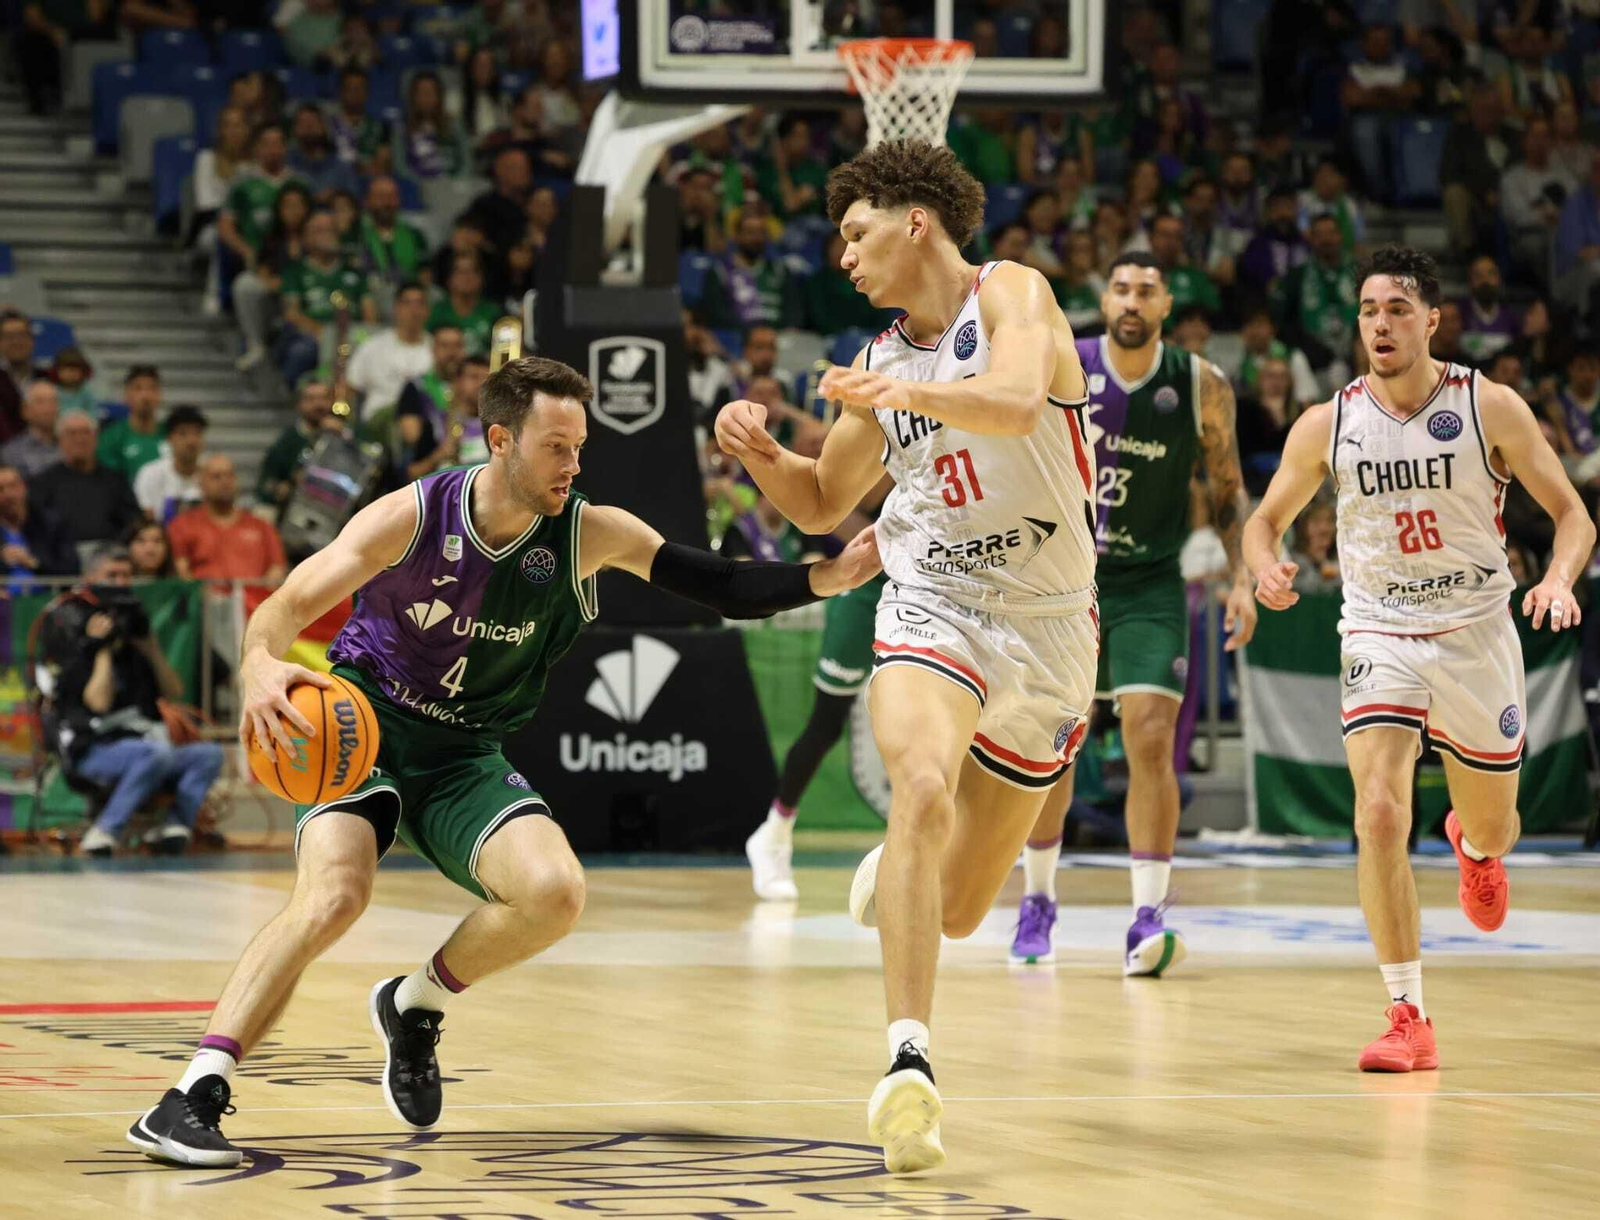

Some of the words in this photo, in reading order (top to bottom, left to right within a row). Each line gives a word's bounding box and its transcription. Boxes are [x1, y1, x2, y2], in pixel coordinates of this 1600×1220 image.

[1105, 434, 1167, 461] Unicaja
[934, 448, 984, 508] 31
[1096, 466, 1133, 507] 23
[1357, 453, 1456, 497] CHOLET
[1395, 509, 1444, 554] 26
[452, 616, 536, 647] Unicaja
[439, 656, 469, 698] 4
[330, 698, 359, 787] Wilson
[559, 732, 708, 782] Unicaja
